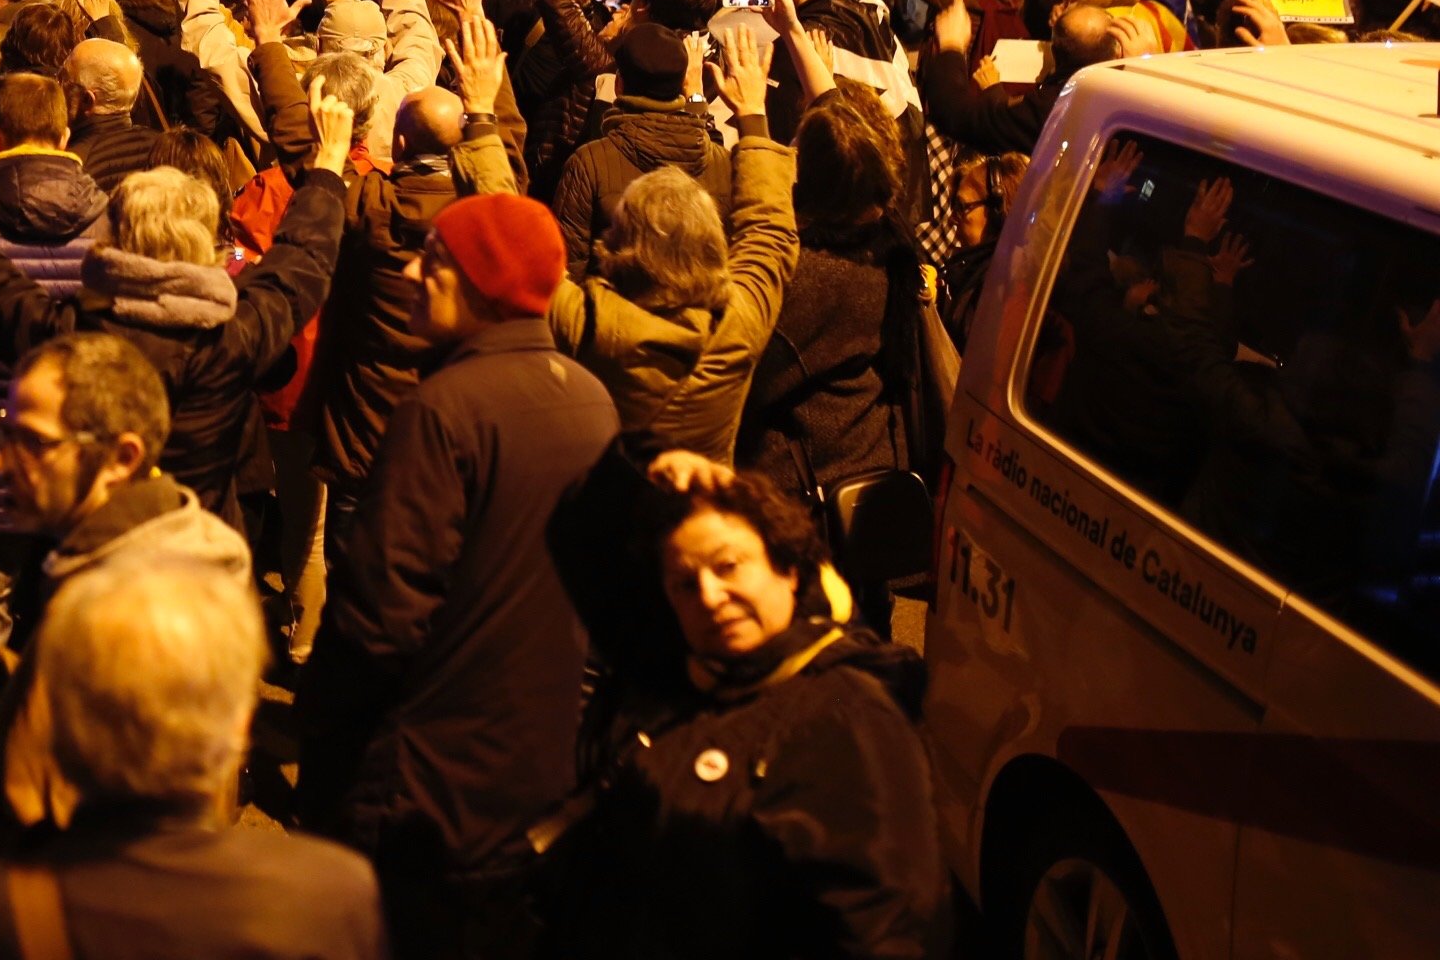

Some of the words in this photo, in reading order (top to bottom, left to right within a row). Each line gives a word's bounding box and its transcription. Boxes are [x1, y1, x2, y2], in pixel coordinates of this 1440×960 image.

[947, 529, 1016, 634] 11.31
[967, 419, 984, 455] La
[985, 439, 1028, 490] ràdio
[1030, 474, 1109, 549] nacional
[1111, 530, 1137, 571] de
[1141, 549, 1258, 654] Catalunya
